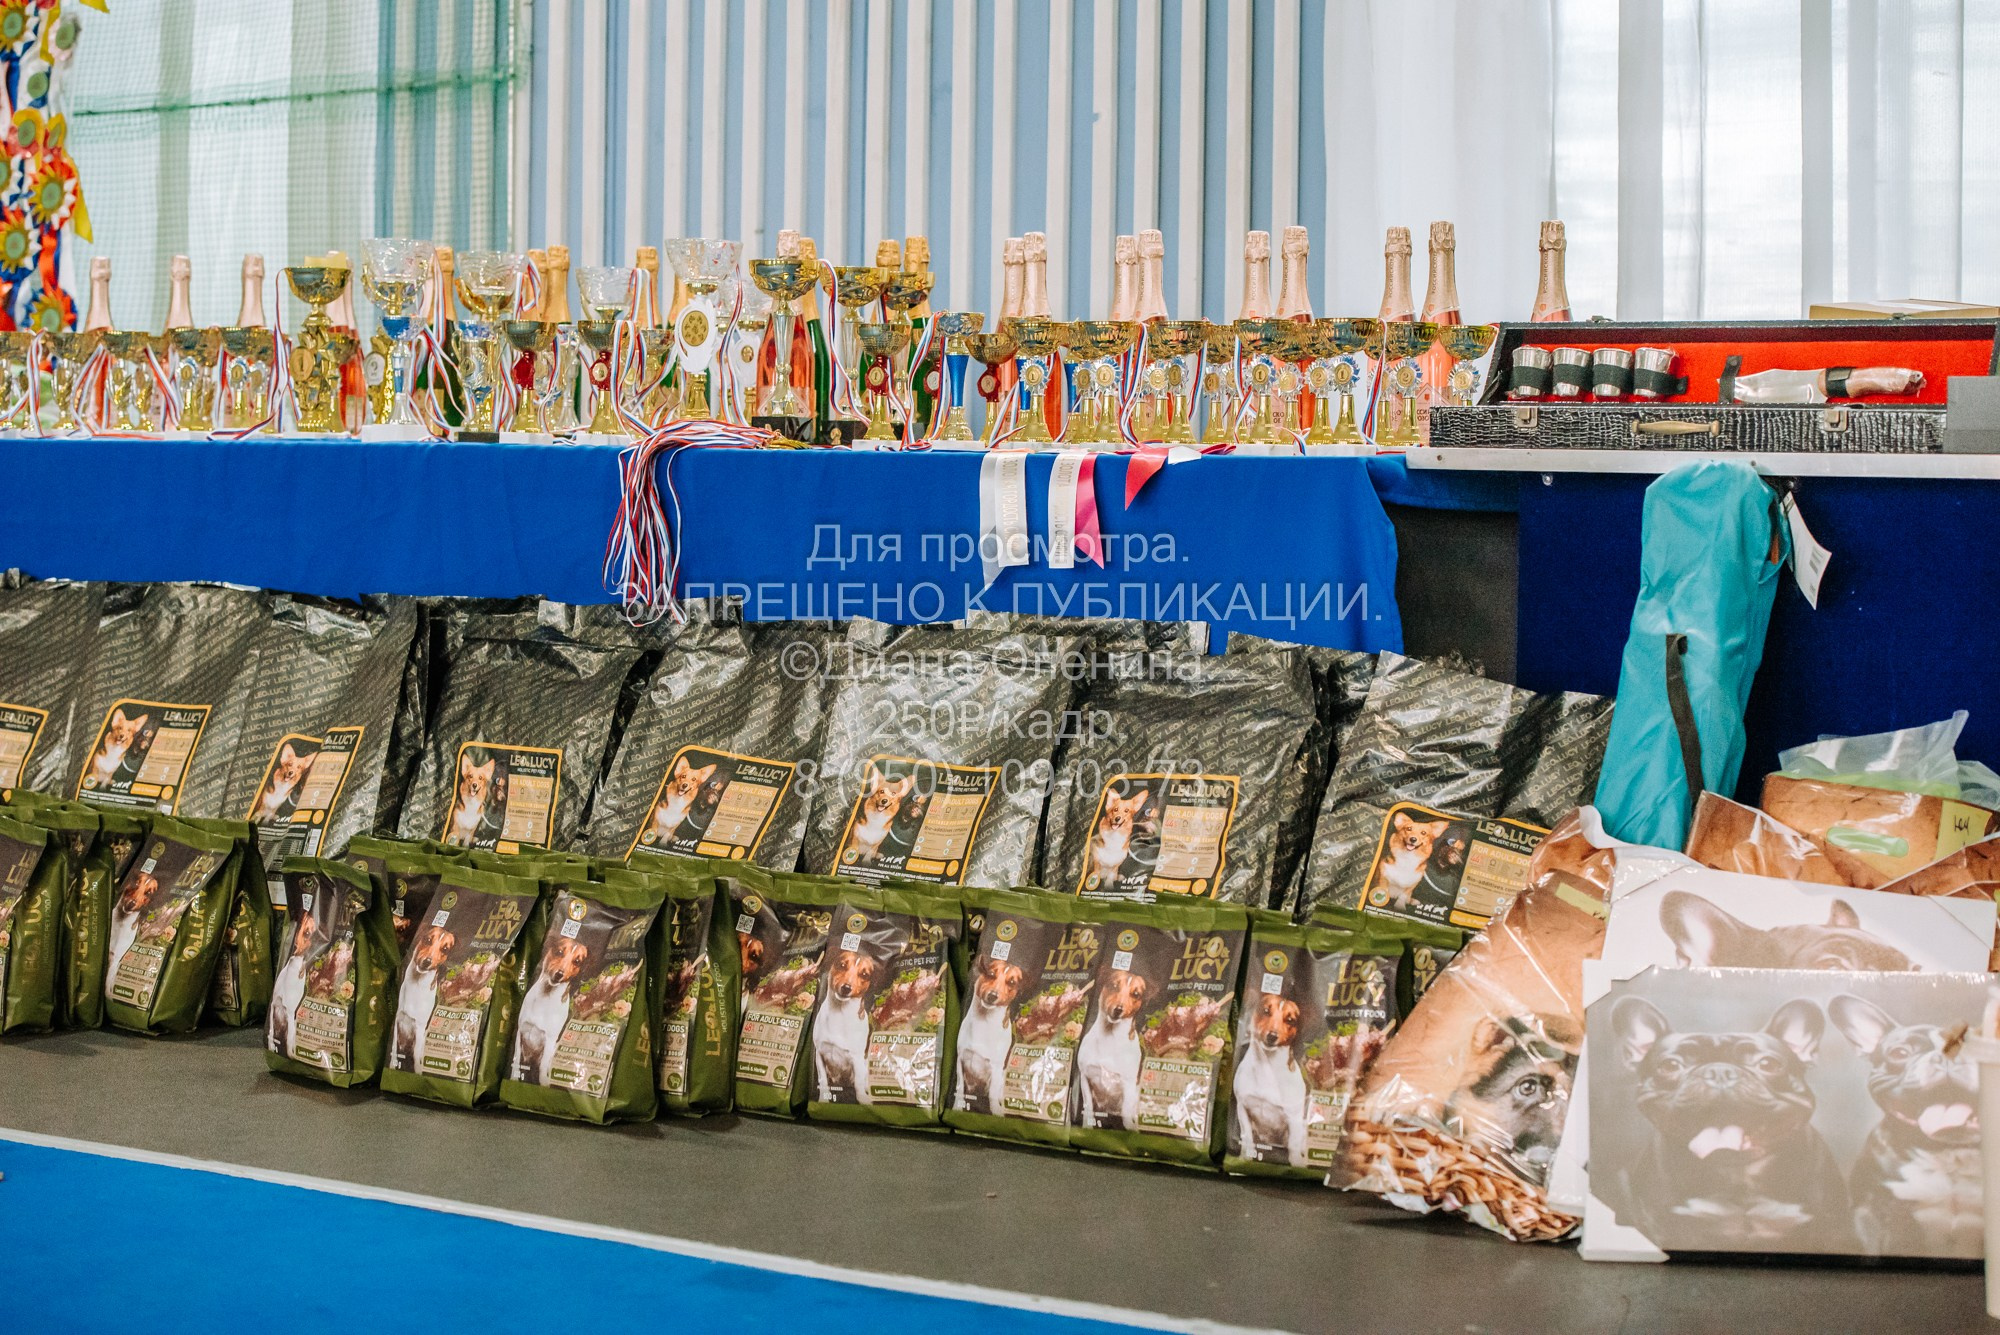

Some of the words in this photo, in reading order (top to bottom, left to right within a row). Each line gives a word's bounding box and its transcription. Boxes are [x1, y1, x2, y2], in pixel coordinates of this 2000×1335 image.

[509, 754, 556, 770] LEO&LUCY
[735, 763, 789, 781] LEO&LUCY
[938, 772, 992, 788] LEO&LUCY
[741, 785, 756, 794] ADULT
[757, 788, 773, 796] DOGS
[1169, 784, 1230, 799] LEO&LUCY
[1206, 812, 1224, 820] DOGS
[1488, 836, 1510, 847] HOLISTIC
[1510, 841, 1519, 850] PET
[1519, 844, 1533, 853] FOOD
[1472, 845, 1489, 855] FOR
[1491, 849, 1516, 862] ADULT
[475, 920, 519, 940] LUCY
[1058, 928, 1099, 950] LEO&
[1182, 936, 1230, 959] LEO&
[914, 958, 924, 966] PET
[1044, 949, 1098, 970] LUCY
[1169, 958, 1230, 980] LUCY
[1337, 960, 1385, 983] LEO&
[1167, 982, 1193, 990] HOLISTIC
[1326, 982, 1386, 1007] LUCY
[302, 1000, 311, 1009] FOR
[310, 1001, 327, 1013] ADULT
[436, 1009, 446, 1017] FOR
[1351, 1009, 1364, 1017] PET
[1365, 1010, 1386, 1018] FOOD
[720, 998, 728, 1033] HOLISTIC
[747, 1013, 760, 1021] FOR
[760, 1014, 780, 1025] ADULT
[780, 1019, 799, 1029] DOGS
[569, 1024, 581, 1032] FOR
[597, 1025, 616, 1036] DOGS
[667, 1024, 685, 1034] DOGS
[322, 1039, 344, 1047] complex
[763, 1041, 778, 1049] BREED
[888, 1035, 910, 1044] ADULT
[770, 1051, 792, 1060] complex
[1014, 1047, 1027, 1056] FOR
[1146, 1062, 1161, 1070] FOR
[1162, 1063, 1187, 1073] ADULT
[1187, 1065, 1208, 1075] DOGS
